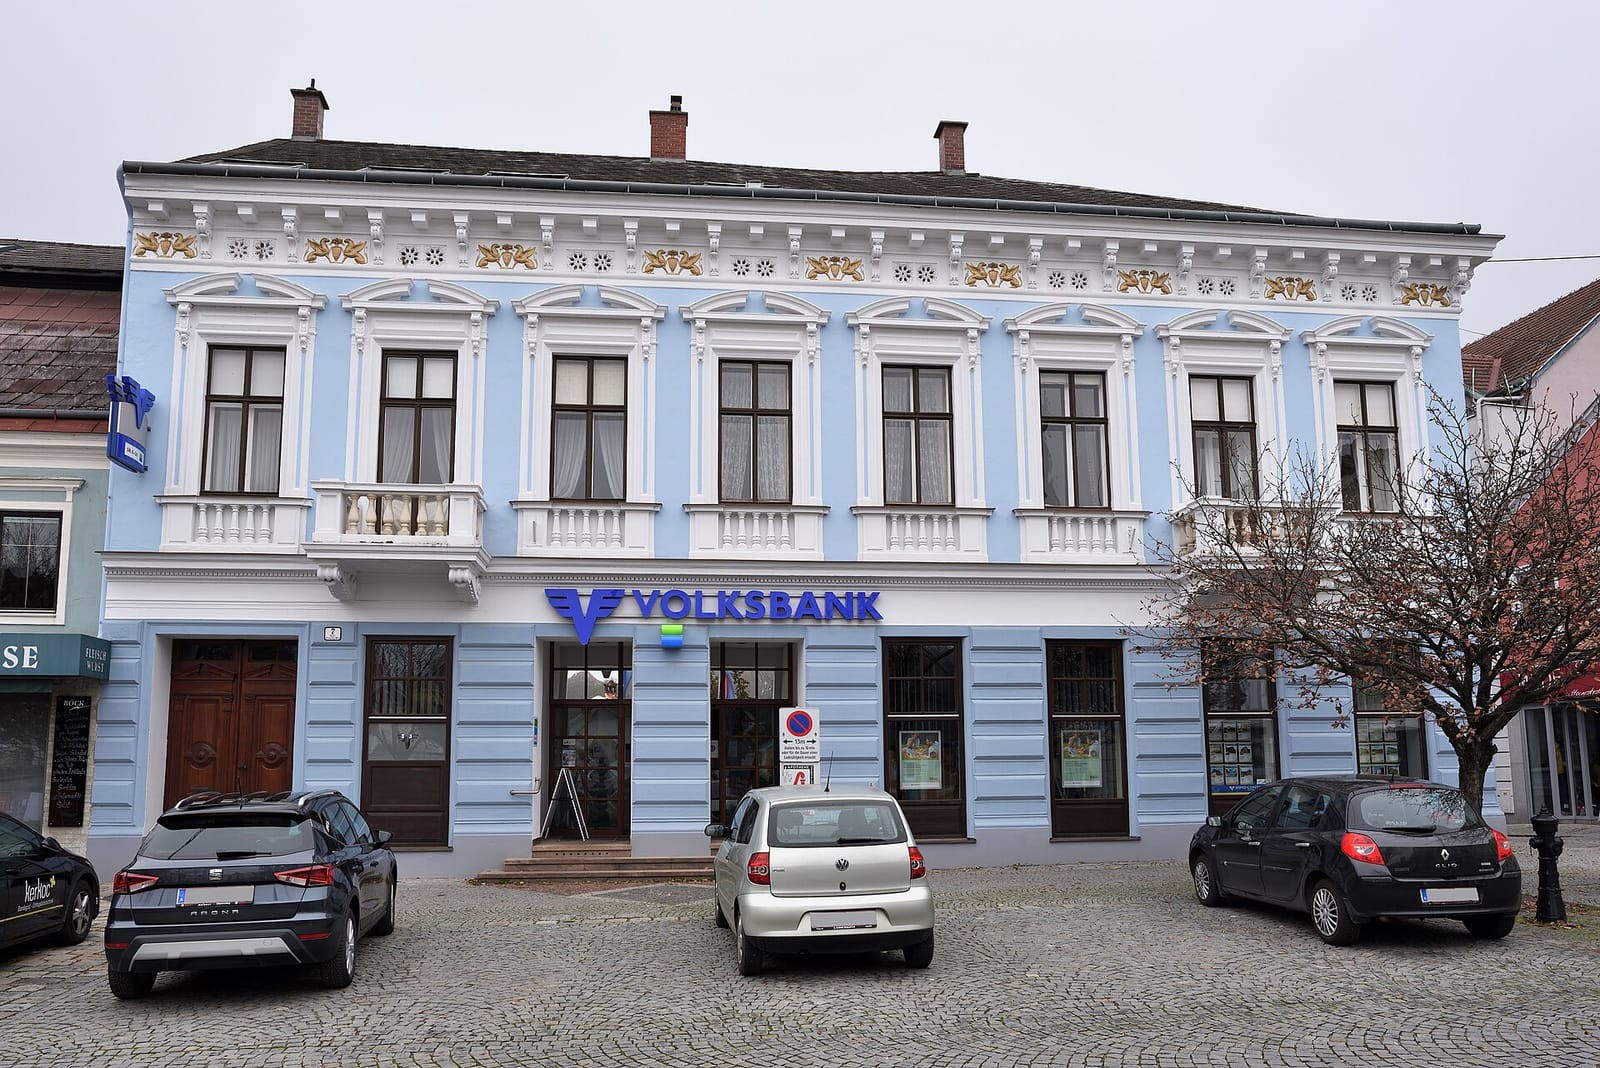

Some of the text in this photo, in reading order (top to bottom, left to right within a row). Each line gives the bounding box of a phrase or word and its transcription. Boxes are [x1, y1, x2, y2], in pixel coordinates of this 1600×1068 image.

[632, 589, 884, 621] VOLKSBANK
[2, 645, 39, 669] SE
[85, 647, 107, 661] FLEISCH
